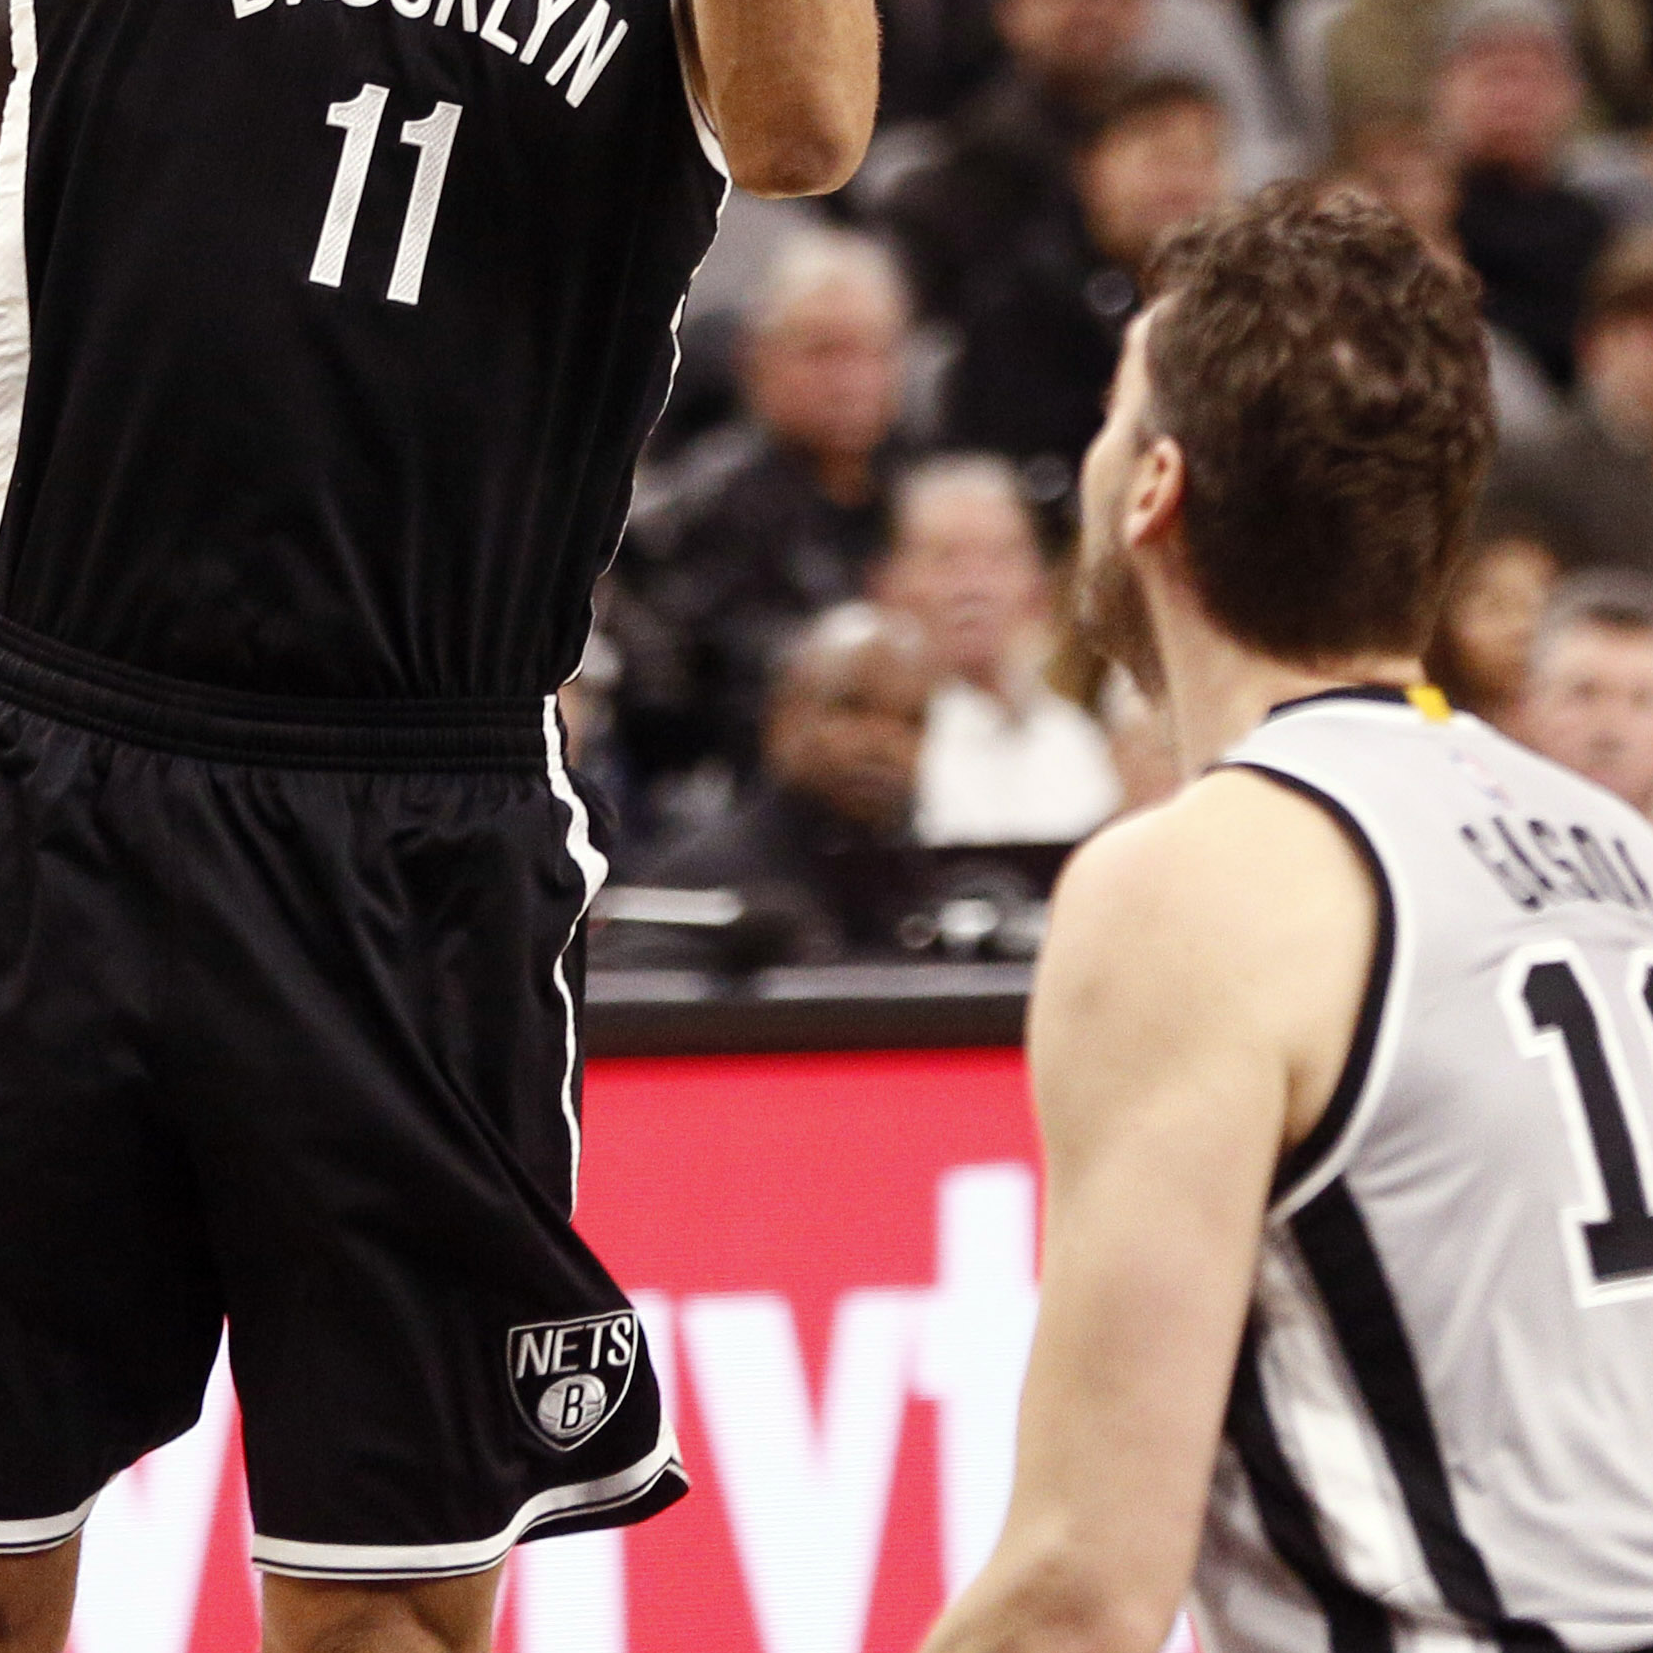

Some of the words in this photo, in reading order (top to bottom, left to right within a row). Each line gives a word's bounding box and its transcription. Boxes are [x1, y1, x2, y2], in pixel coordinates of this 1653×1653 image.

[309, 83, 463, 305] 11
[515, 1315, 633, 1380] NETS
[560, 1383, 585, 1430] B
